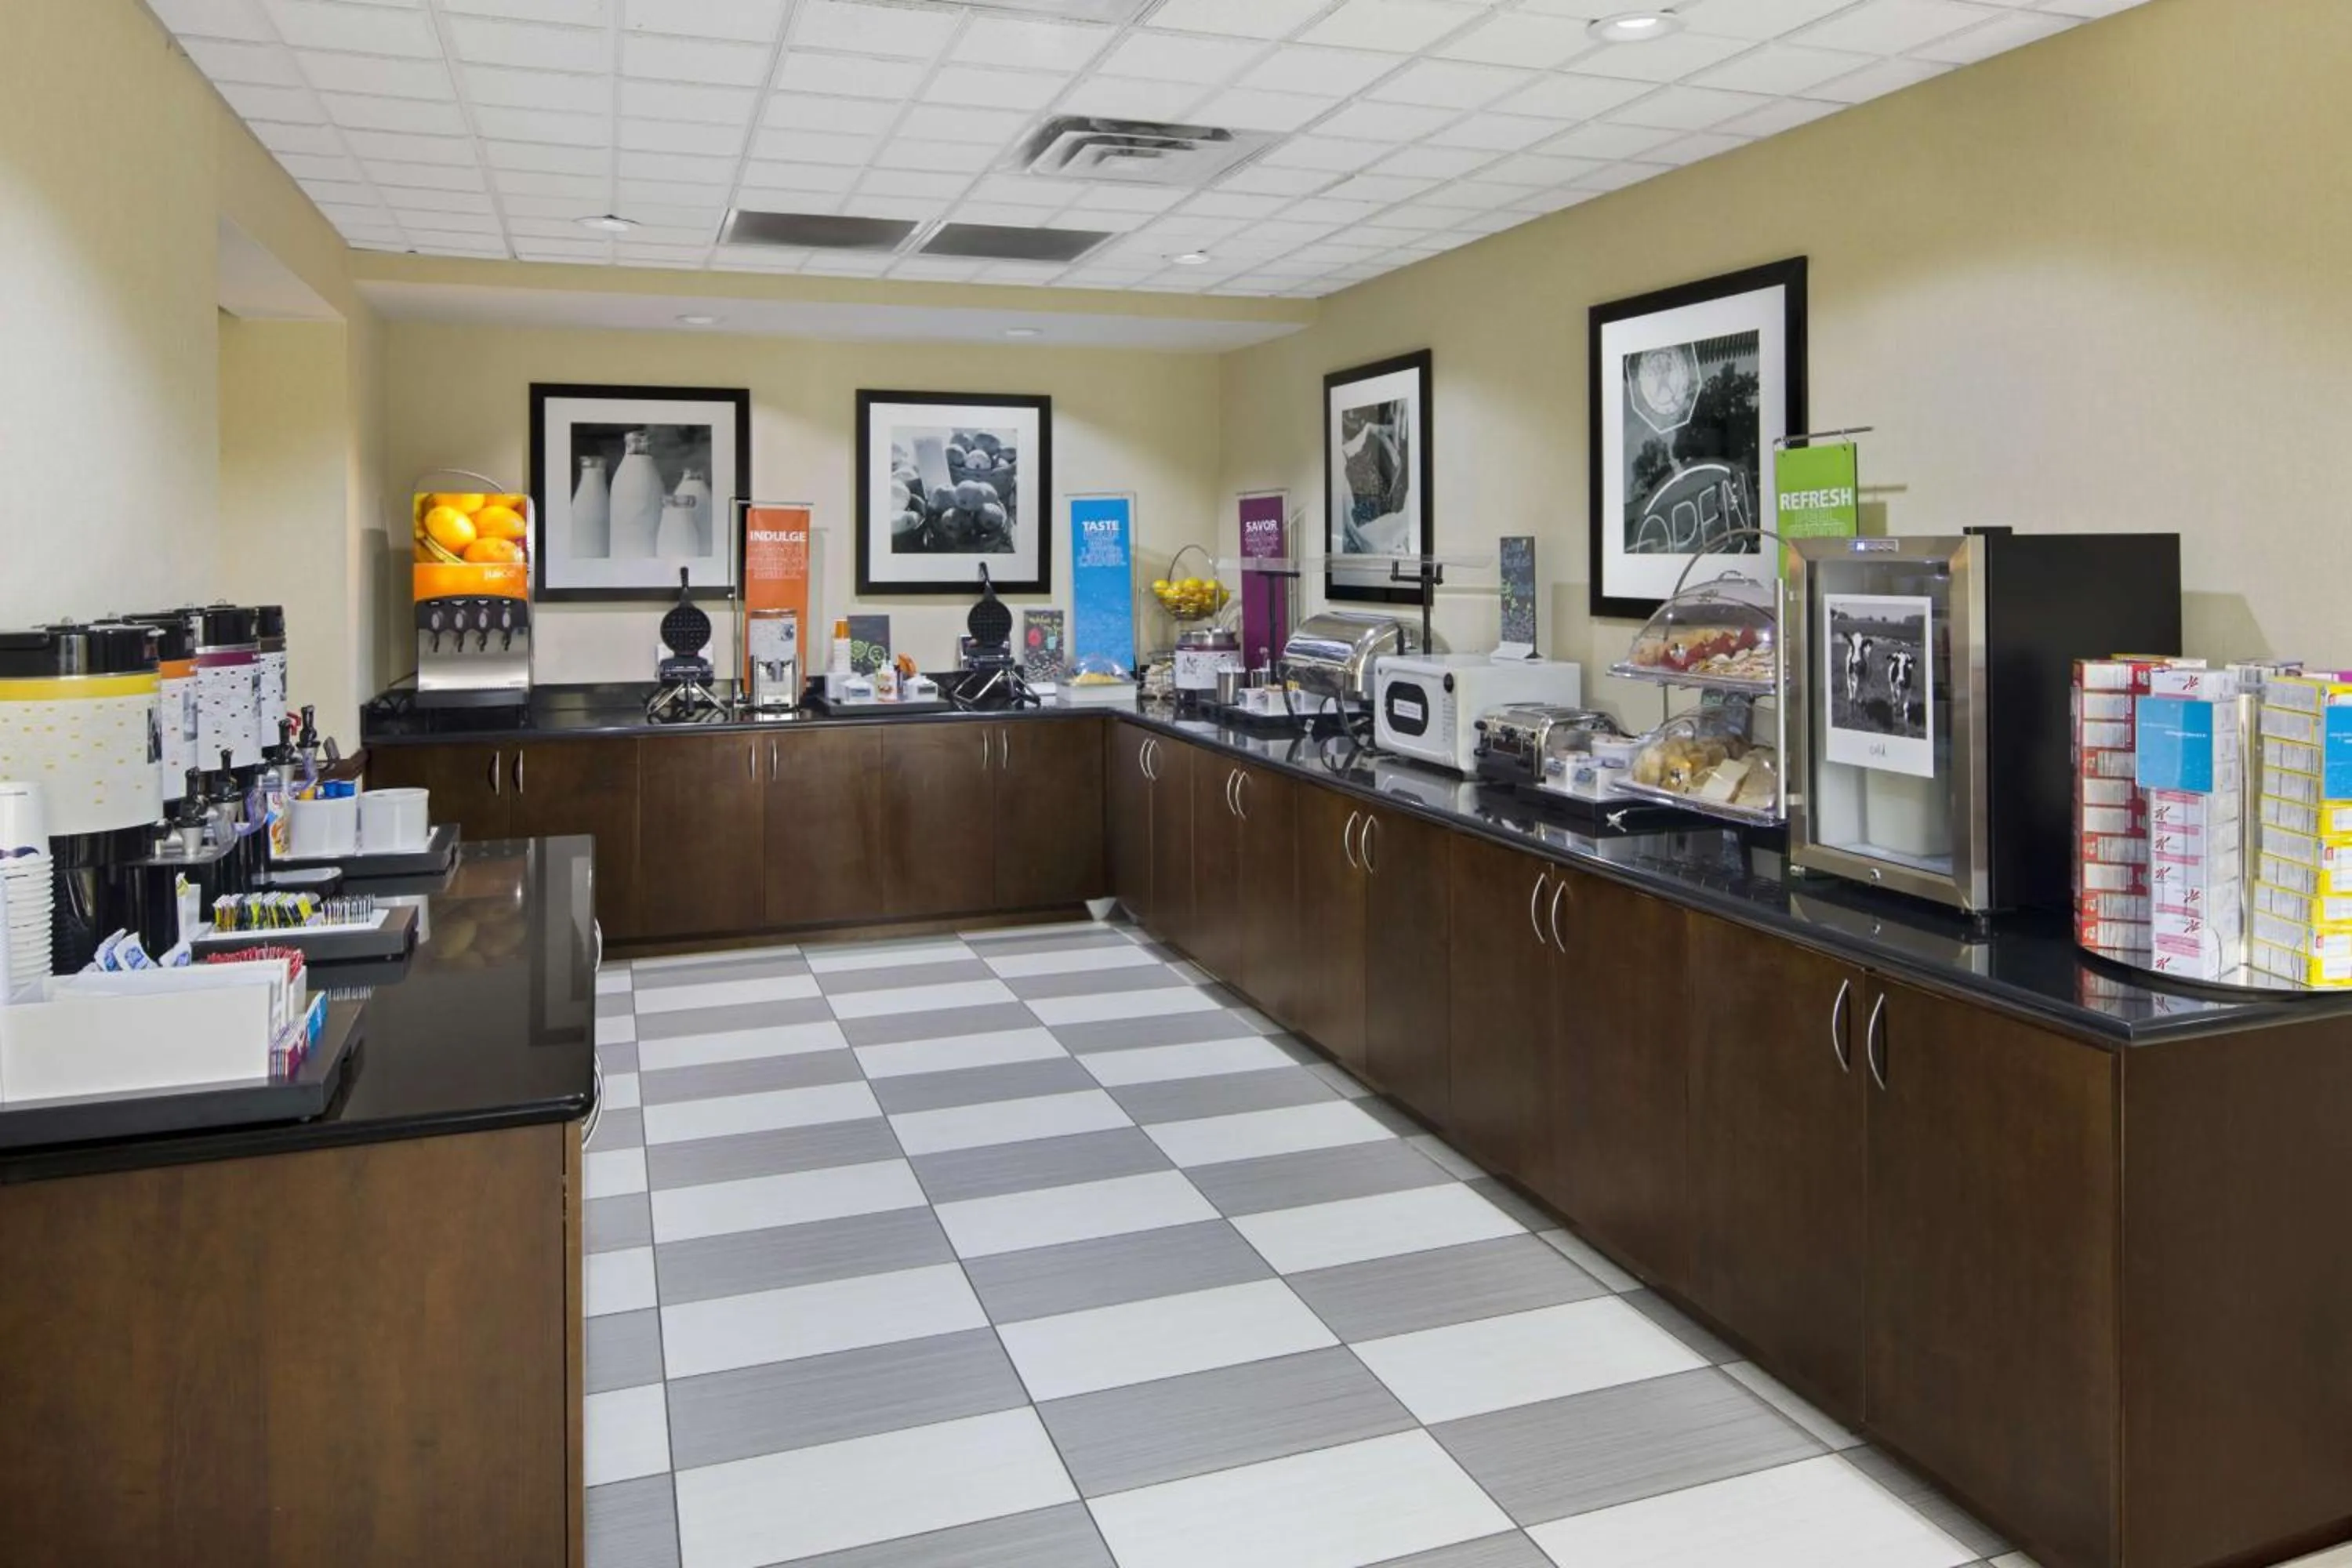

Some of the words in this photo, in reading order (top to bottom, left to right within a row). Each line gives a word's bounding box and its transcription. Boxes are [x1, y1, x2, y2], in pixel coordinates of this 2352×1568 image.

[1780, 487, 1853, 510] REFRESH
[1082, 520, 1121, 531] TASTE
[1245, 519, 1278, 532] SAVOR
[750, 530, 808, 542] INDULGE
